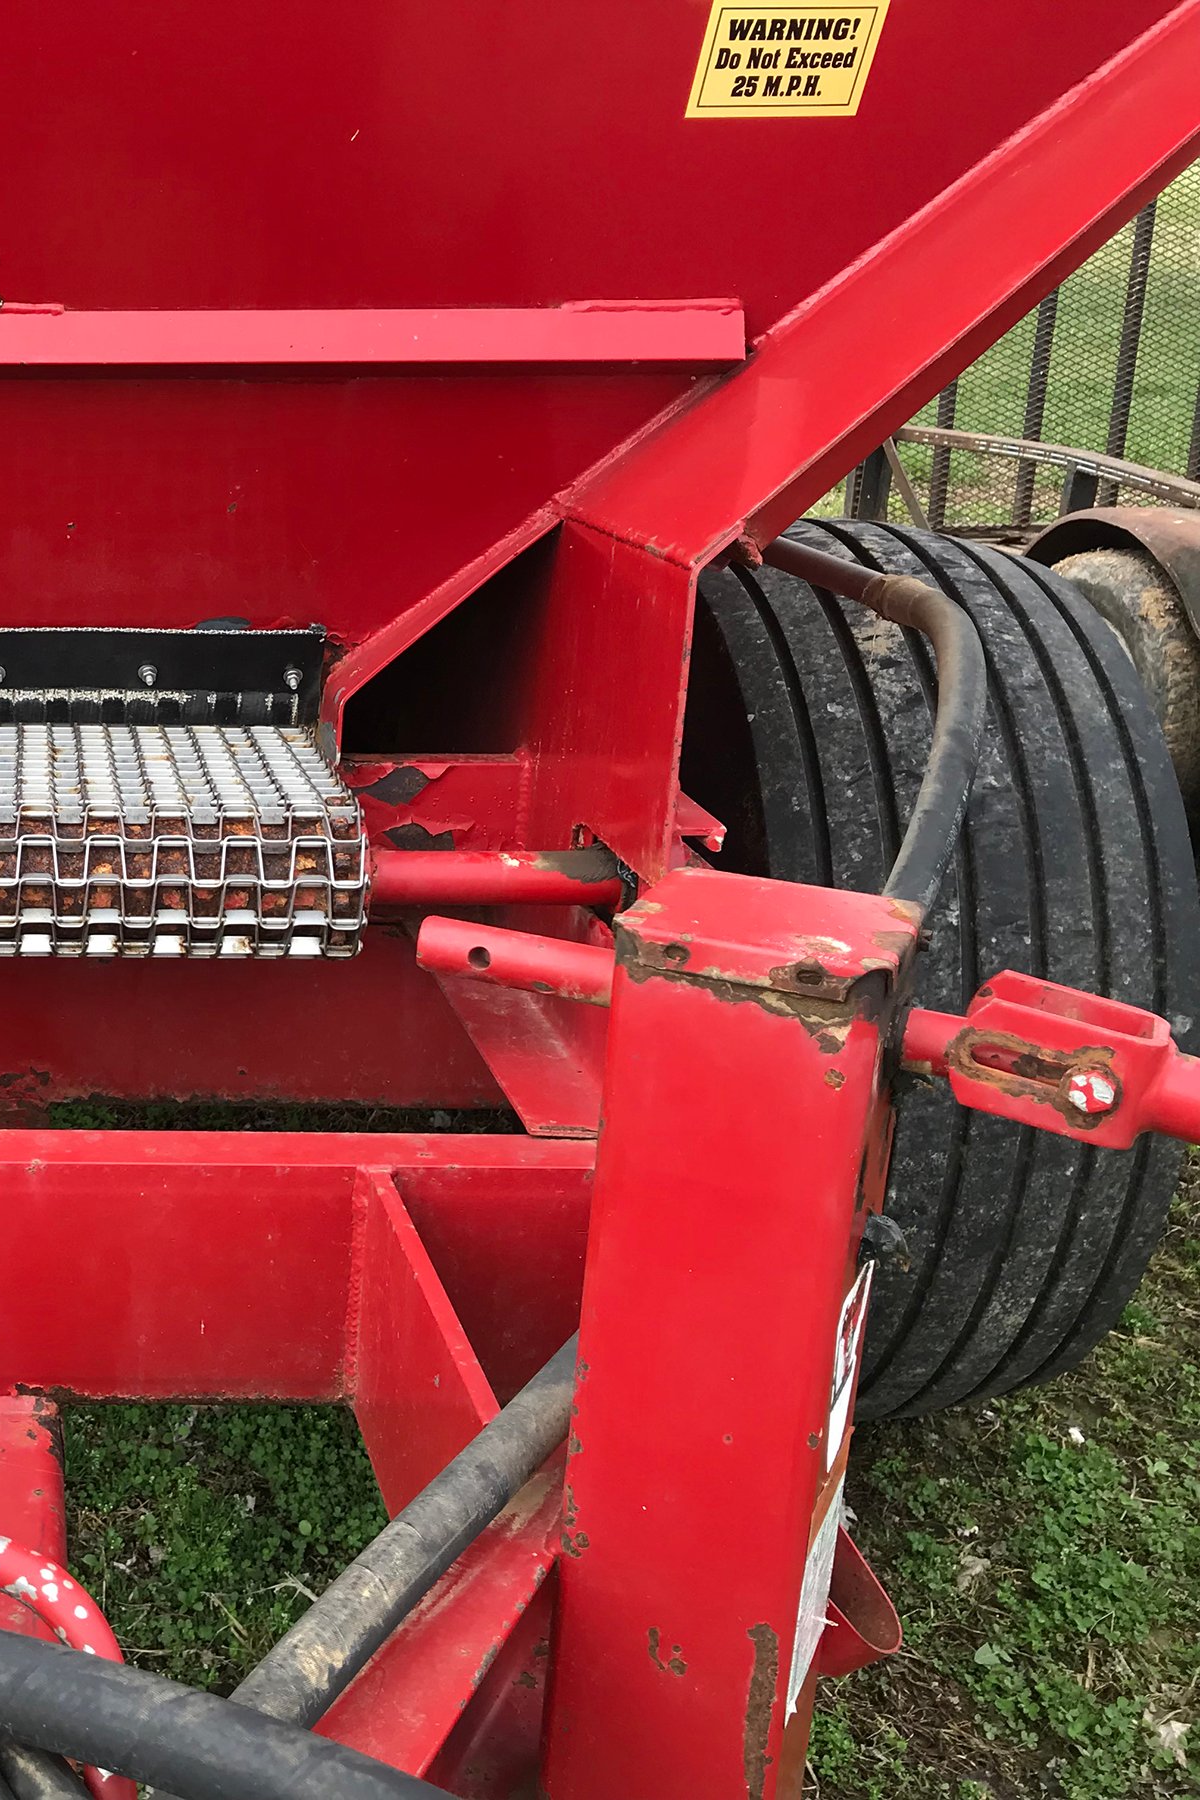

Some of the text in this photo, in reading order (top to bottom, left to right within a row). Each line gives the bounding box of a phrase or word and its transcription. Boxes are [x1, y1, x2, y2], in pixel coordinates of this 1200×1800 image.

[728, 18, 861, 41] WARNING!
[715, 47, 858, 69] Do Not Exceed
[730, 75, 822, 97] 25 M.P.H.
